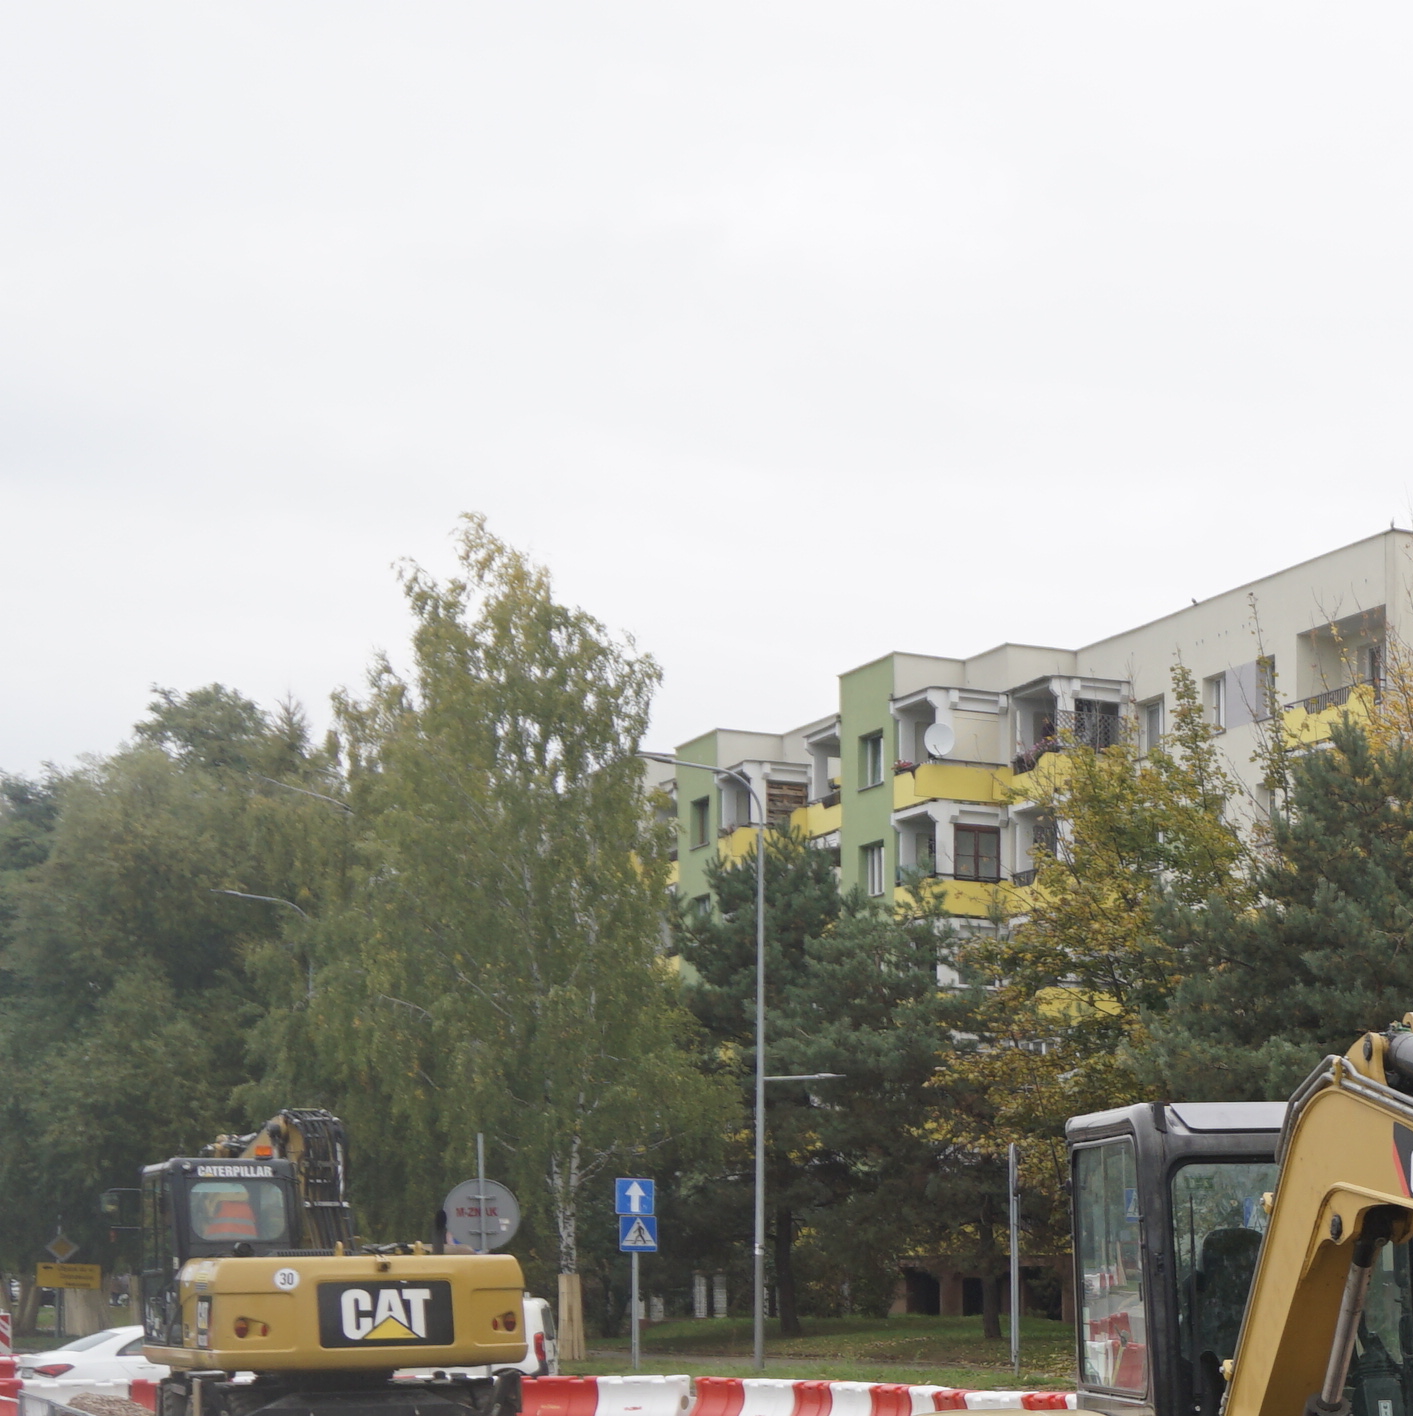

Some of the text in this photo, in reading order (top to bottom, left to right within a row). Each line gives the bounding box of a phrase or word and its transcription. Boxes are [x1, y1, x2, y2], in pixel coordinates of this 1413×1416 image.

[197, 1165, 273, 1177] CATERPILLAR
[279, 1272, 294, 1286] 30
[341, 1288, 431, 1340] CAT
